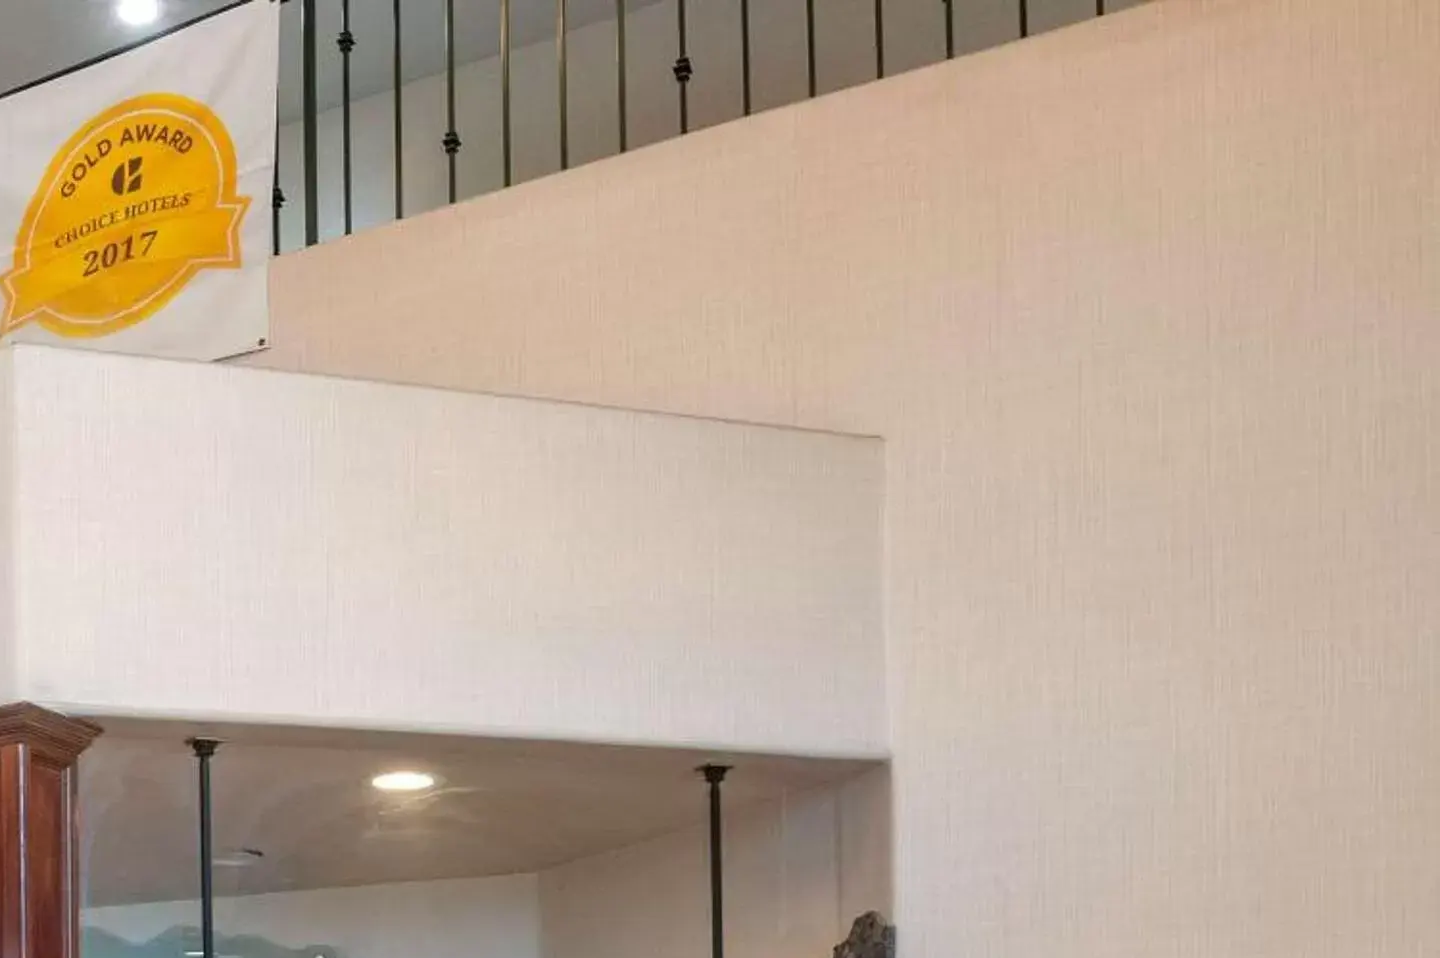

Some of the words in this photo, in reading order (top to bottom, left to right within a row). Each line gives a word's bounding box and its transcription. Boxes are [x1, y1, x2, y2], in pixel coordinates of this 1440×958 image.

[60, 138, 113, 199] GOLD
[119, 123, 194, 155] AWARD
[54, 207, 121, 249] CHOICE
[124, 192, 192, 221] HOTELS
[82, 230, 159, 277] 2017
